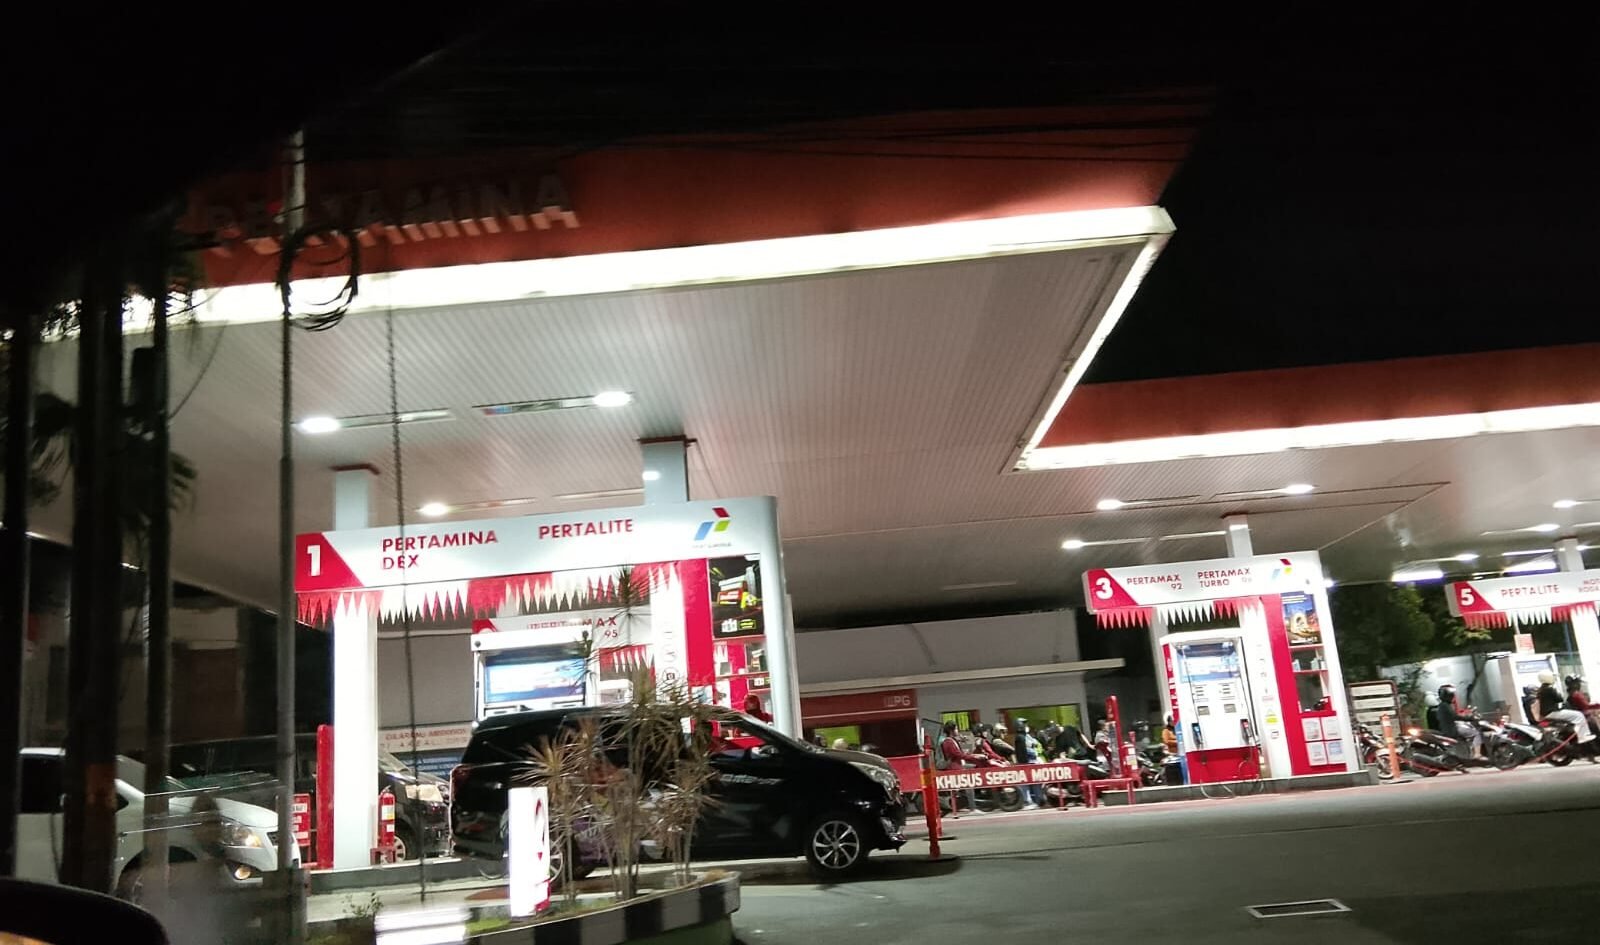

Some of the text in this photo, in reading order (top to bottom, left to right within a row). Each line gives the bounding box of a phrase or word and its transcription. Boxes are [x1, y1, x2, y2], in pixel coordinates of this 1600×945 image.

[538, 518, 634, 540] PERTALITE
[382, 530, 498, 553] PERTAMINA
[307, 545, 321, 577] 1
[382, 554, 420, 571] DEX
[1126, 574, 1181, 586] PERTAMAX
[1197, 567, 1251, 580] PERTAMAX
[1095, 577, 1114, 600] 3
[1170, 583, 1184, 591] 92
[1199, 579, 1230, 588] TURBO
[1501, 584, 1560, 597] PERTALITE
[1460, 588, 1475, 606] 5
[604, 630, 618, 638] 95
[935, 766, 1073, 790] KHUSUS SEPEDA MOTOR
